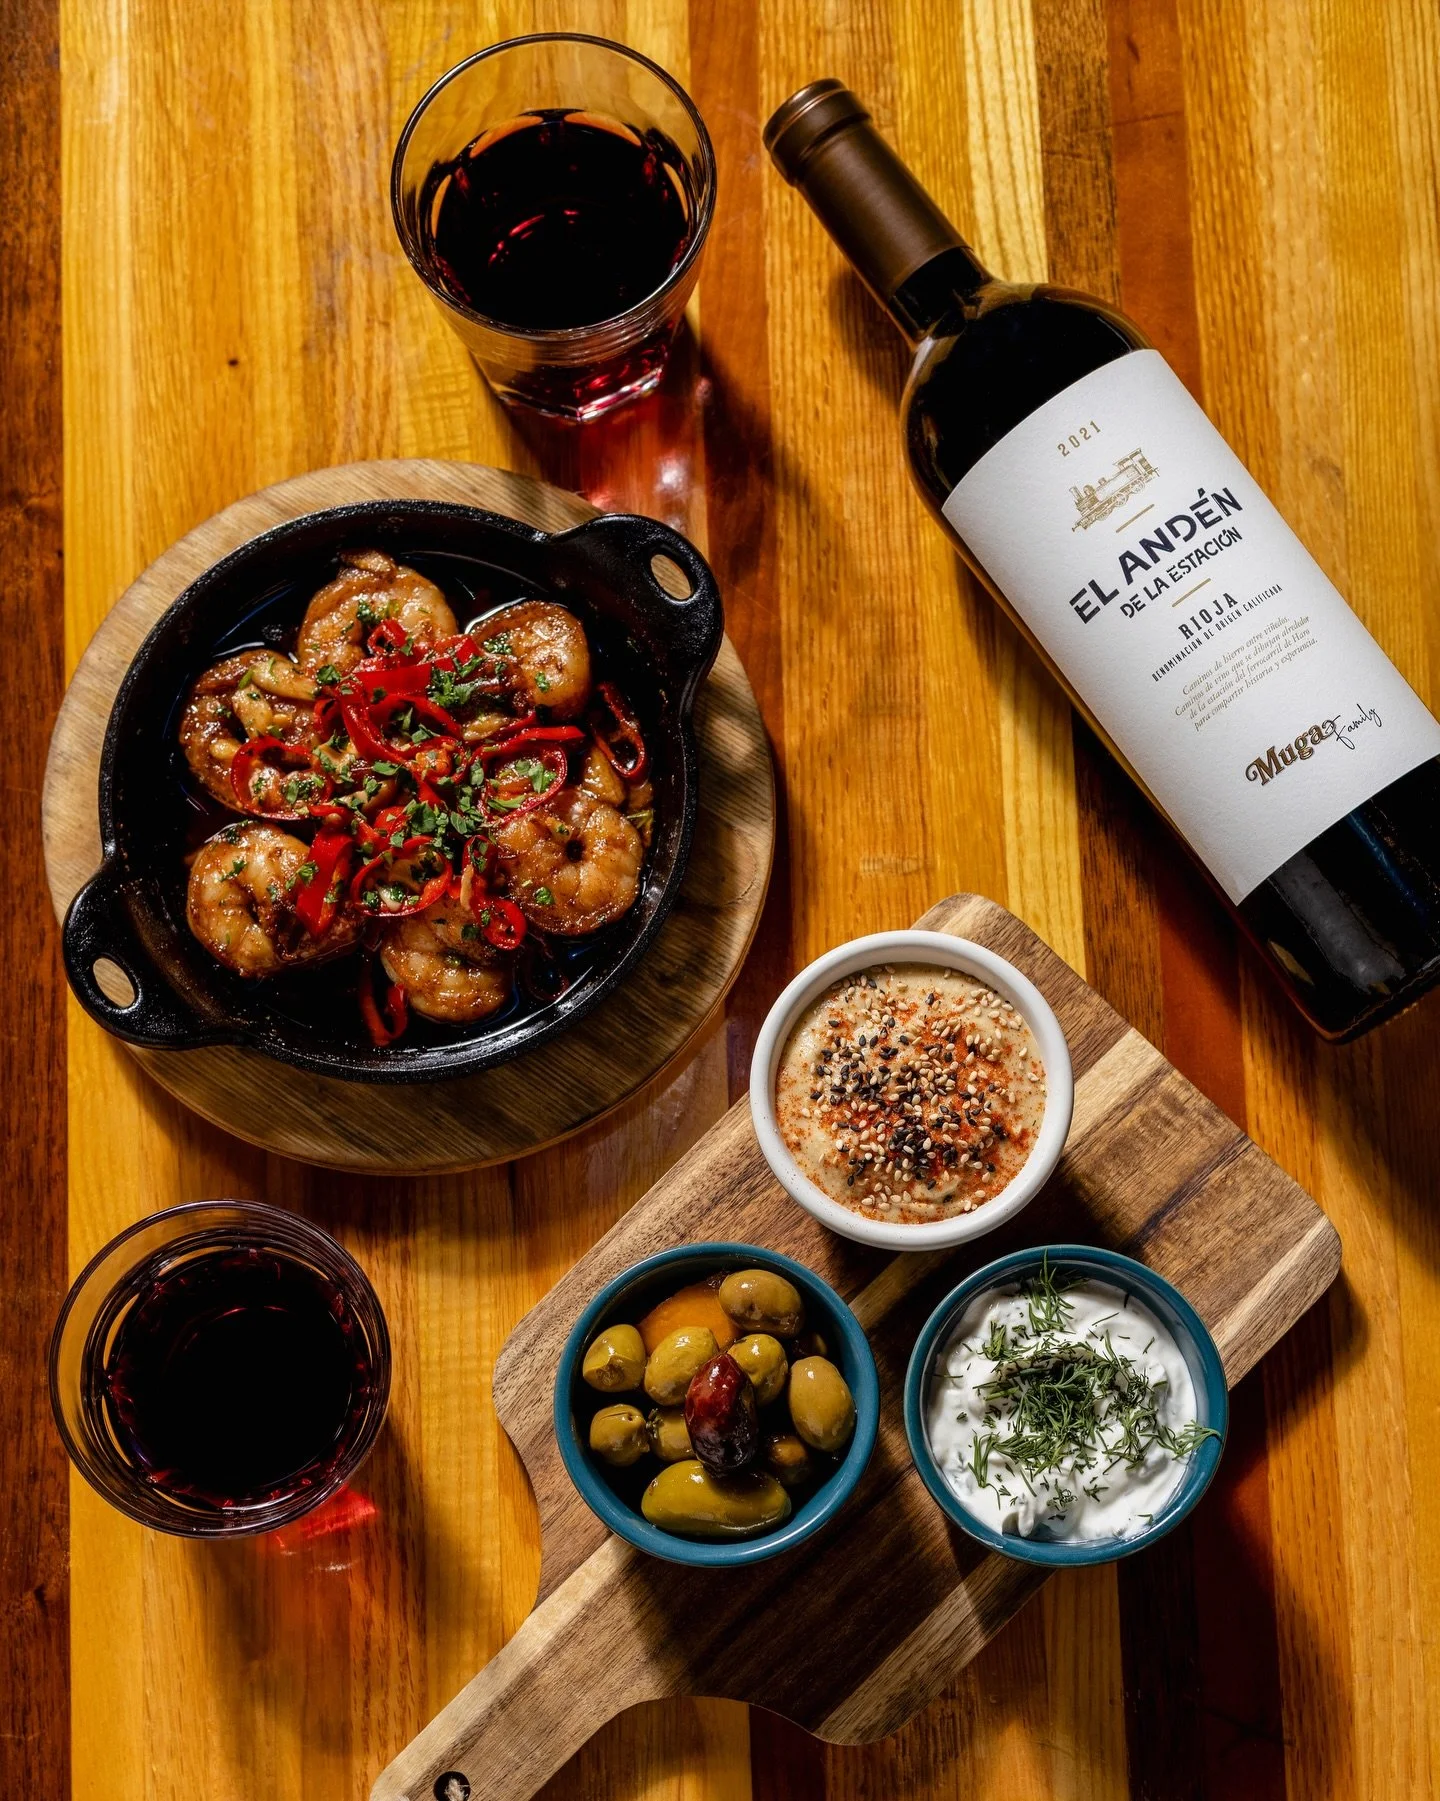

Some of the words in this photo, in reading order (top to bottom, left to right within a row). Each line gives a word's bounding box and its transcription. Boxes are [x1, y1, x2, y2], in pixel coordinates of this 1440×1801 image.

[1057, 421, 1101, 457] 2021
[1069, 579, 1120, 624] EL
[1118, 487, 1243, 586] ANDÉN
[1120, 593, 1146, 619] DE
[1143, 577, 1170, 601] LA
[1166, 526, 1243, 583] ESTACIÓN
[1178, 593, 1238, 640] RIOJA
[1203, 628, 1214, 640] DE
[1215, 609, 1242, 631] ORIGEN
[1242, 584, 1283, 612] CALIFICADA
[1175, 690, 1205, 716] Caminos
[1205, 682, 1214, 693] de
[1214, 670, 1230, 685] vino
[1231, 659, 1245, 674] que
[1245, 654, 1252, 663] se
[1253, 634, 1281, 656] dibujan
[1182, 669, 1213, 695] Caminos
[1214, 661, 1223, 672] de
[1246, 632, 1263, 648] entre
[1190, 708, 1198, 720] de
[1197, 702, 1206, 712] la
[1206, 681, 1234, 705] estación
[1235, 668, 1246, 684] del
[1247, 642, 1283, 677] ferrocarril
[1284, 639, 1293, 649] de
[1291, 629, 1310, 643] Haro
[1194, 713, 1211, 732] para
[1211, 686, 1243, 716] compartir
[1274, 661, 1280, 670] y
[1245, 719, 1337, 786] Muga
